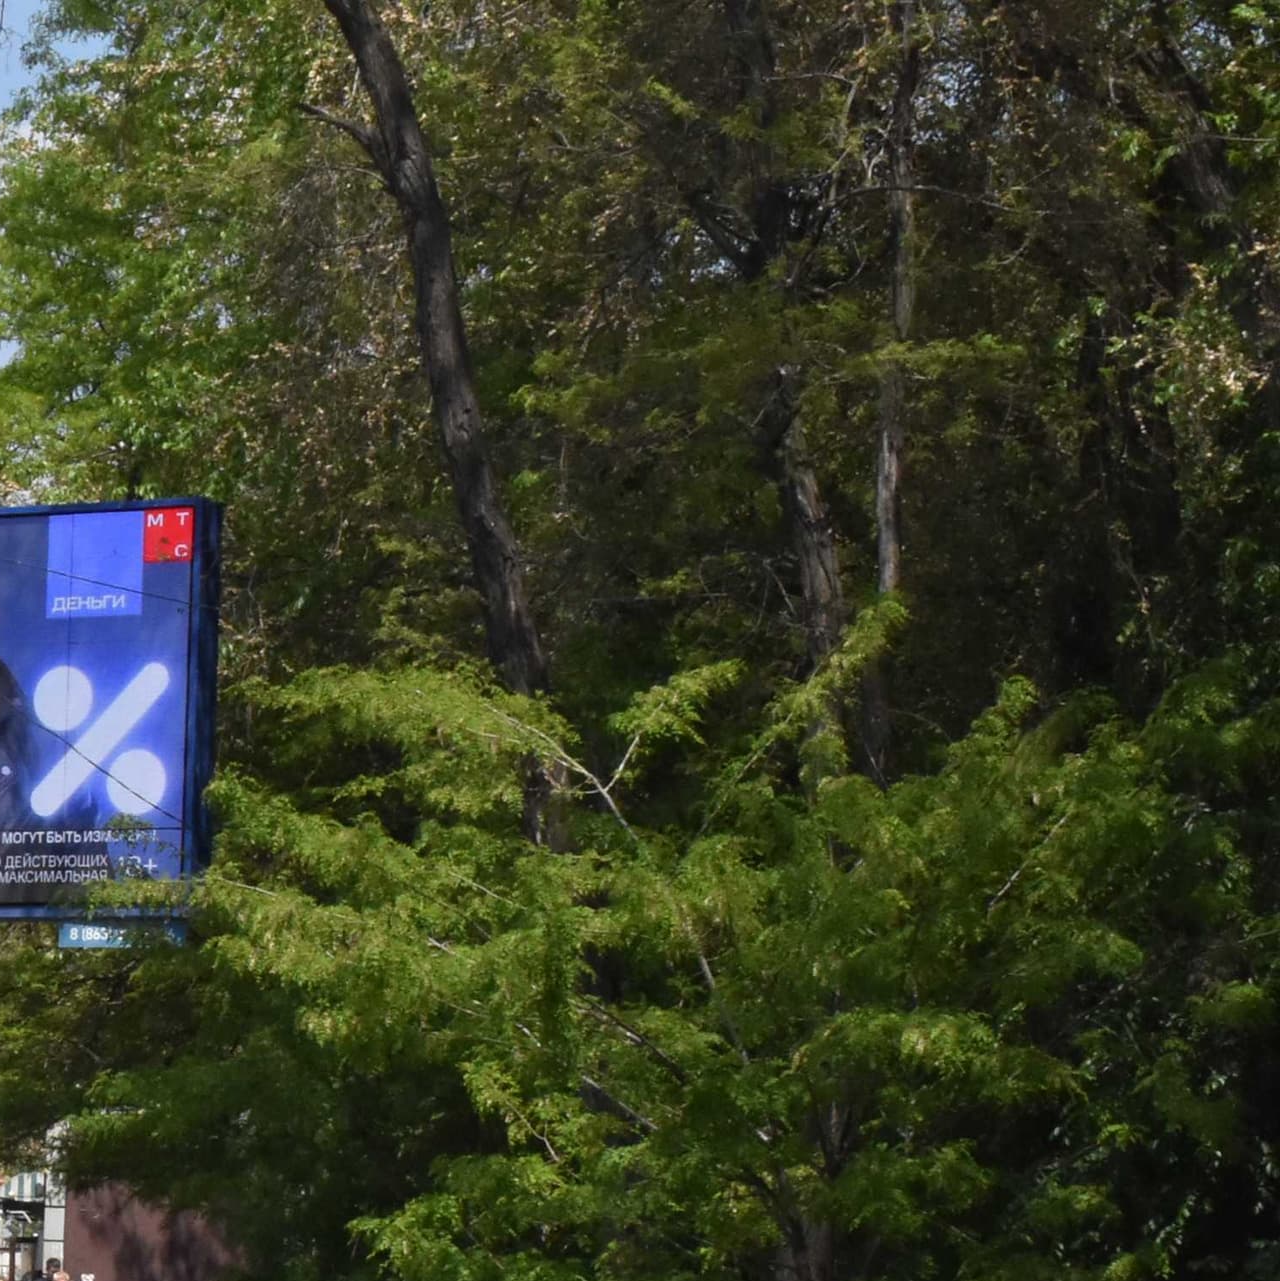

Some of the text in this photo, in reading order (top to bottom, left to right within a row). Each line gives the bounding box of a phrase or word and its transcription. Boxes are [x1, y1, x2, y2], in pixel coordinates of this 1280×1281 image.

[52, 594, 126, 613] ДЕНЬГИ
[2, 831, 44, 844] МОГУТ
[46, 830, 81, 843] БЫТЬ
[5, 853, 108, 869] ДЕЙСТВУЮЩИХ
